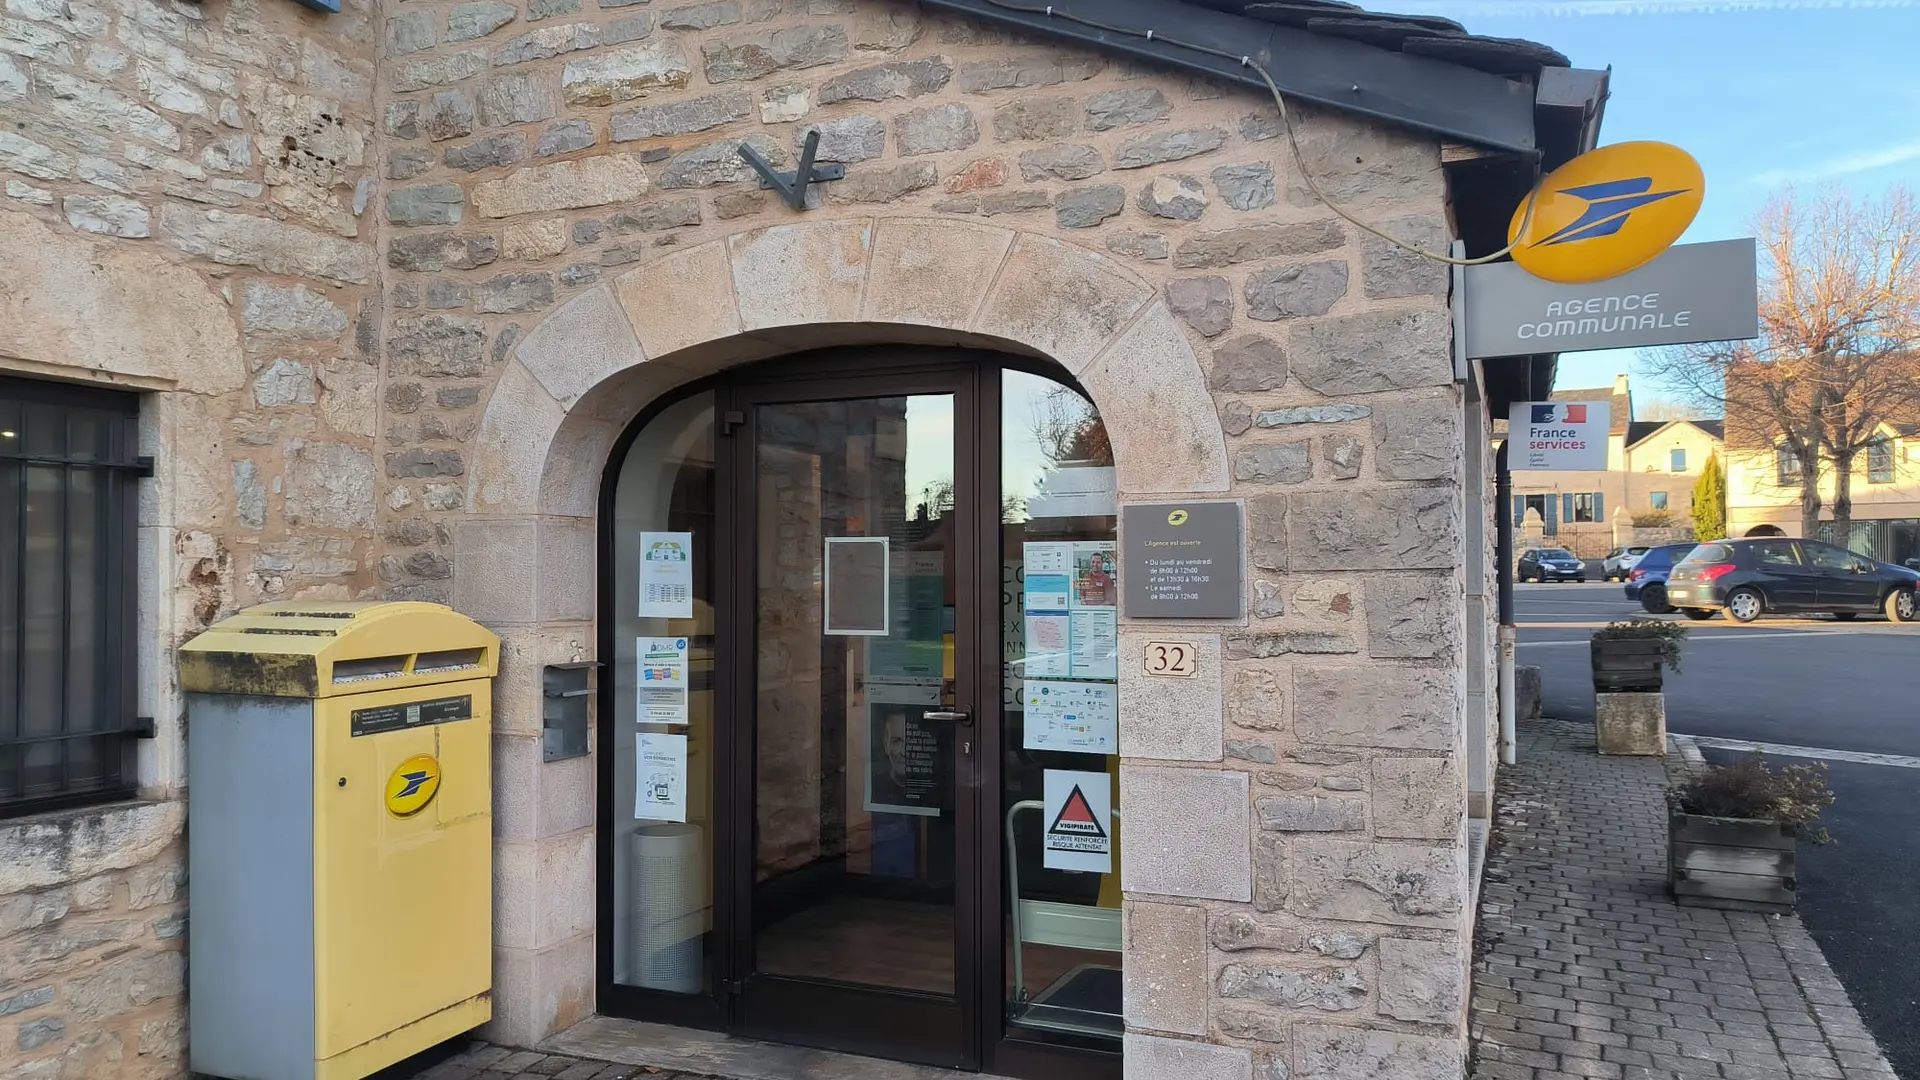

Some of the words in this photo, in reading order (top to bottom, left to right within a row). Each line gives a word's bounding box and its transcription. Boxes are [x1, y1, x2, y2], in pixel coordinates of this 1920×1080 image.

[1546, 293, 1660, 317] AGENCE
[1517, 311, 1691, 339] COMMUNALE
[1530, 427, 1576, 438] France
[1529, 438, 1586, 450] services
[1154, 646, 1184, 671] 32
[1075, 842, 1102, 850] ATTENTAT
